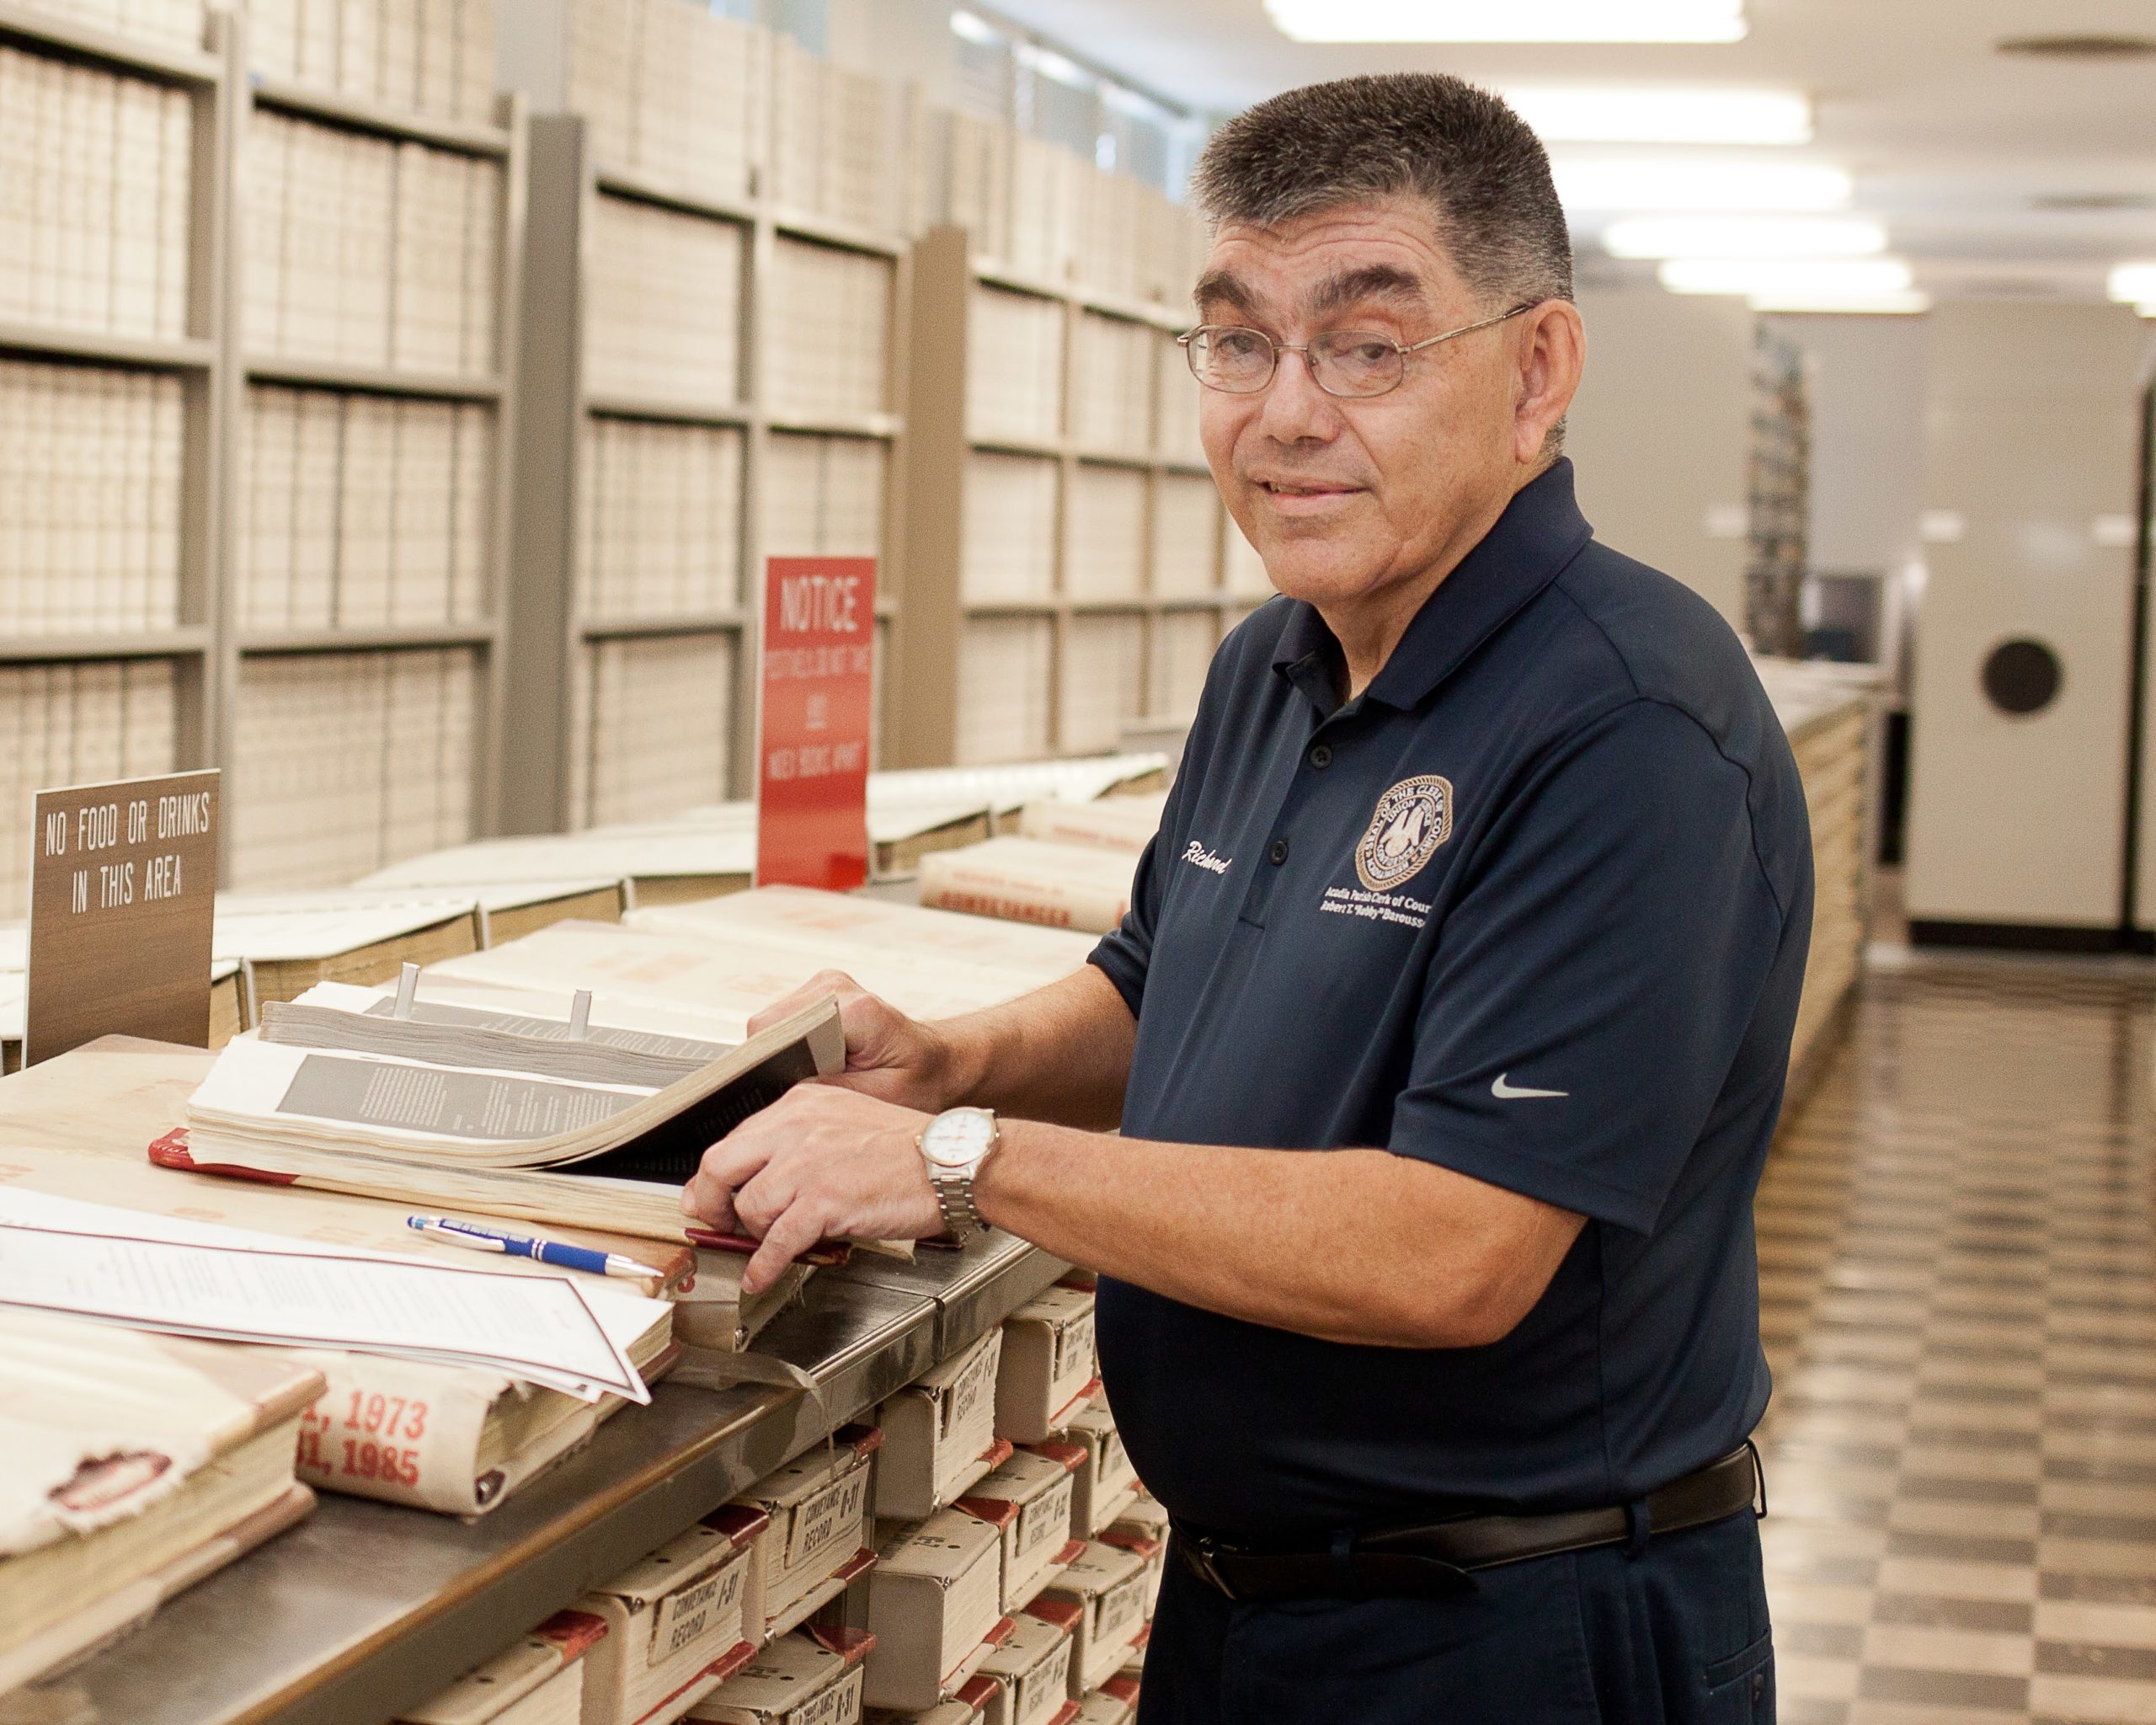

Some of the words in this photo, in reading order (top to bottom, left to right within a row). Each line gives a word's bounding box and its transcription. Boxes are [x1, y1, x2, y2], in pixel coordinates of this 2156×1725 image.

[781, 575, 859, 632] NOTICE
[1386, 799, 1416, 823] UNION
[1391, 788, 1415, 803] THE
[45, 811, 67, 857] NO
[77, 804, 118, 852] FOOD
[127, 800, 147, 844] OR
[157, 792, 210, 839] DRINKS
[72, 870, 88, 914] IN
[100, 862, 134, 909] THIS
[144, 855, 181, 901] AREA
[1350, 889, 1371, 902] Parish
[1371, 893, 1392, 905] Clerk
[1391, 895, 1406, 907] of
[344, 1390, 428, 1440] 1973
[342, 1438, 419, 1487] 1985
[803, 1517, 832, 1555] RECORD
[670, 1610, 706, 1651] RECORD
